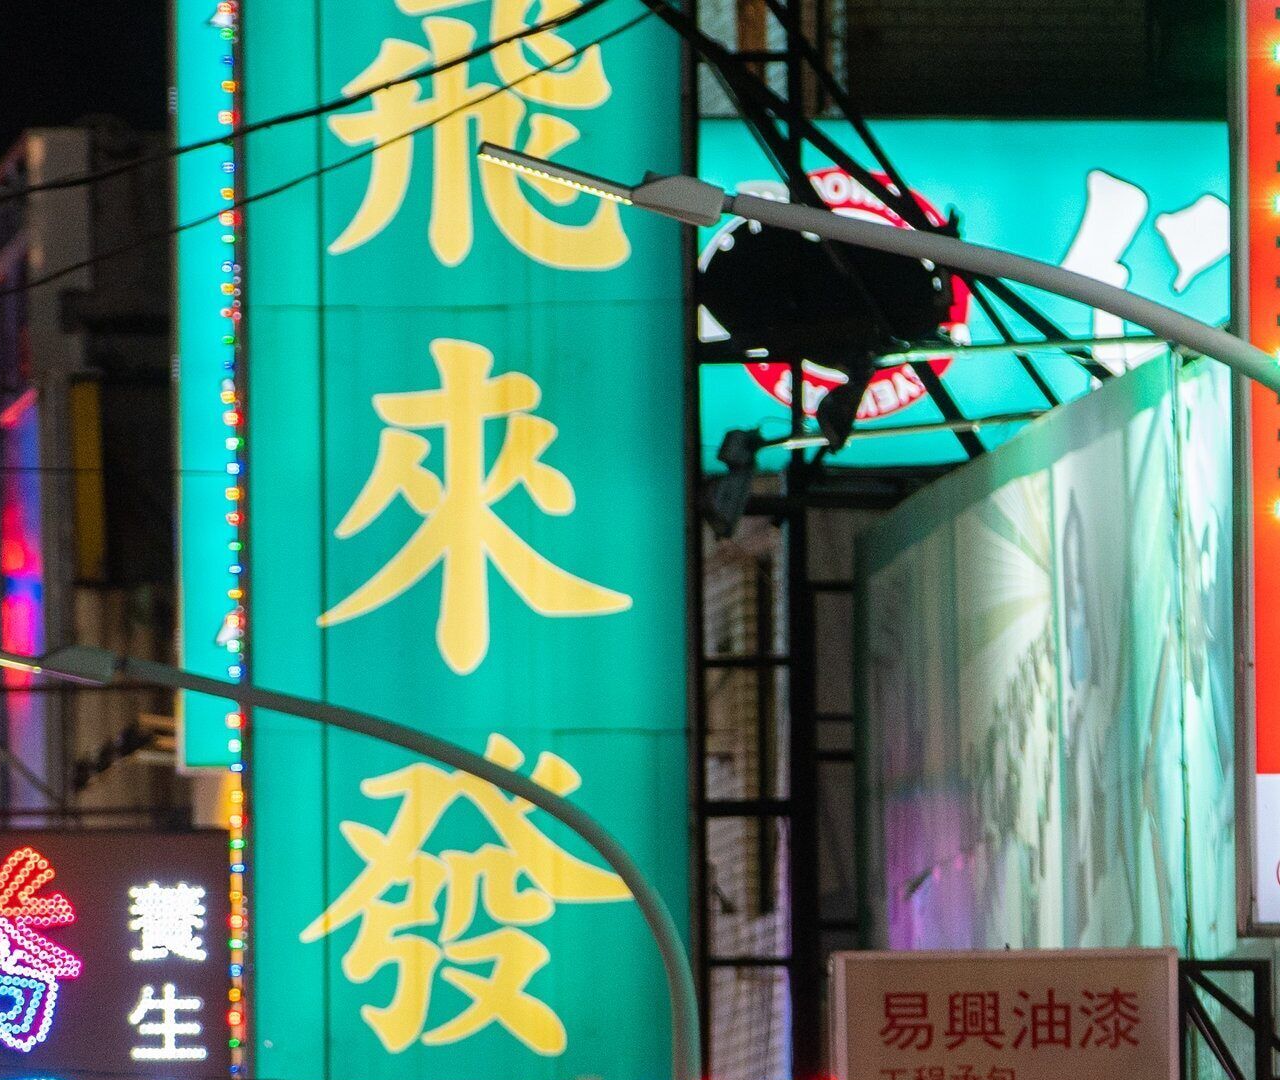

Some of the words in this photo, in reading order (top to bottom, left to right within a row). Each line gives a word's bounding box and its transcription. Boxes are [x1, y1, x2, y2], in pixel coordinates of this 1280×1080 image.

[299, 0, 634, 1057] 飛來發
[878, 987, 1141, 1051] 易興油漆
